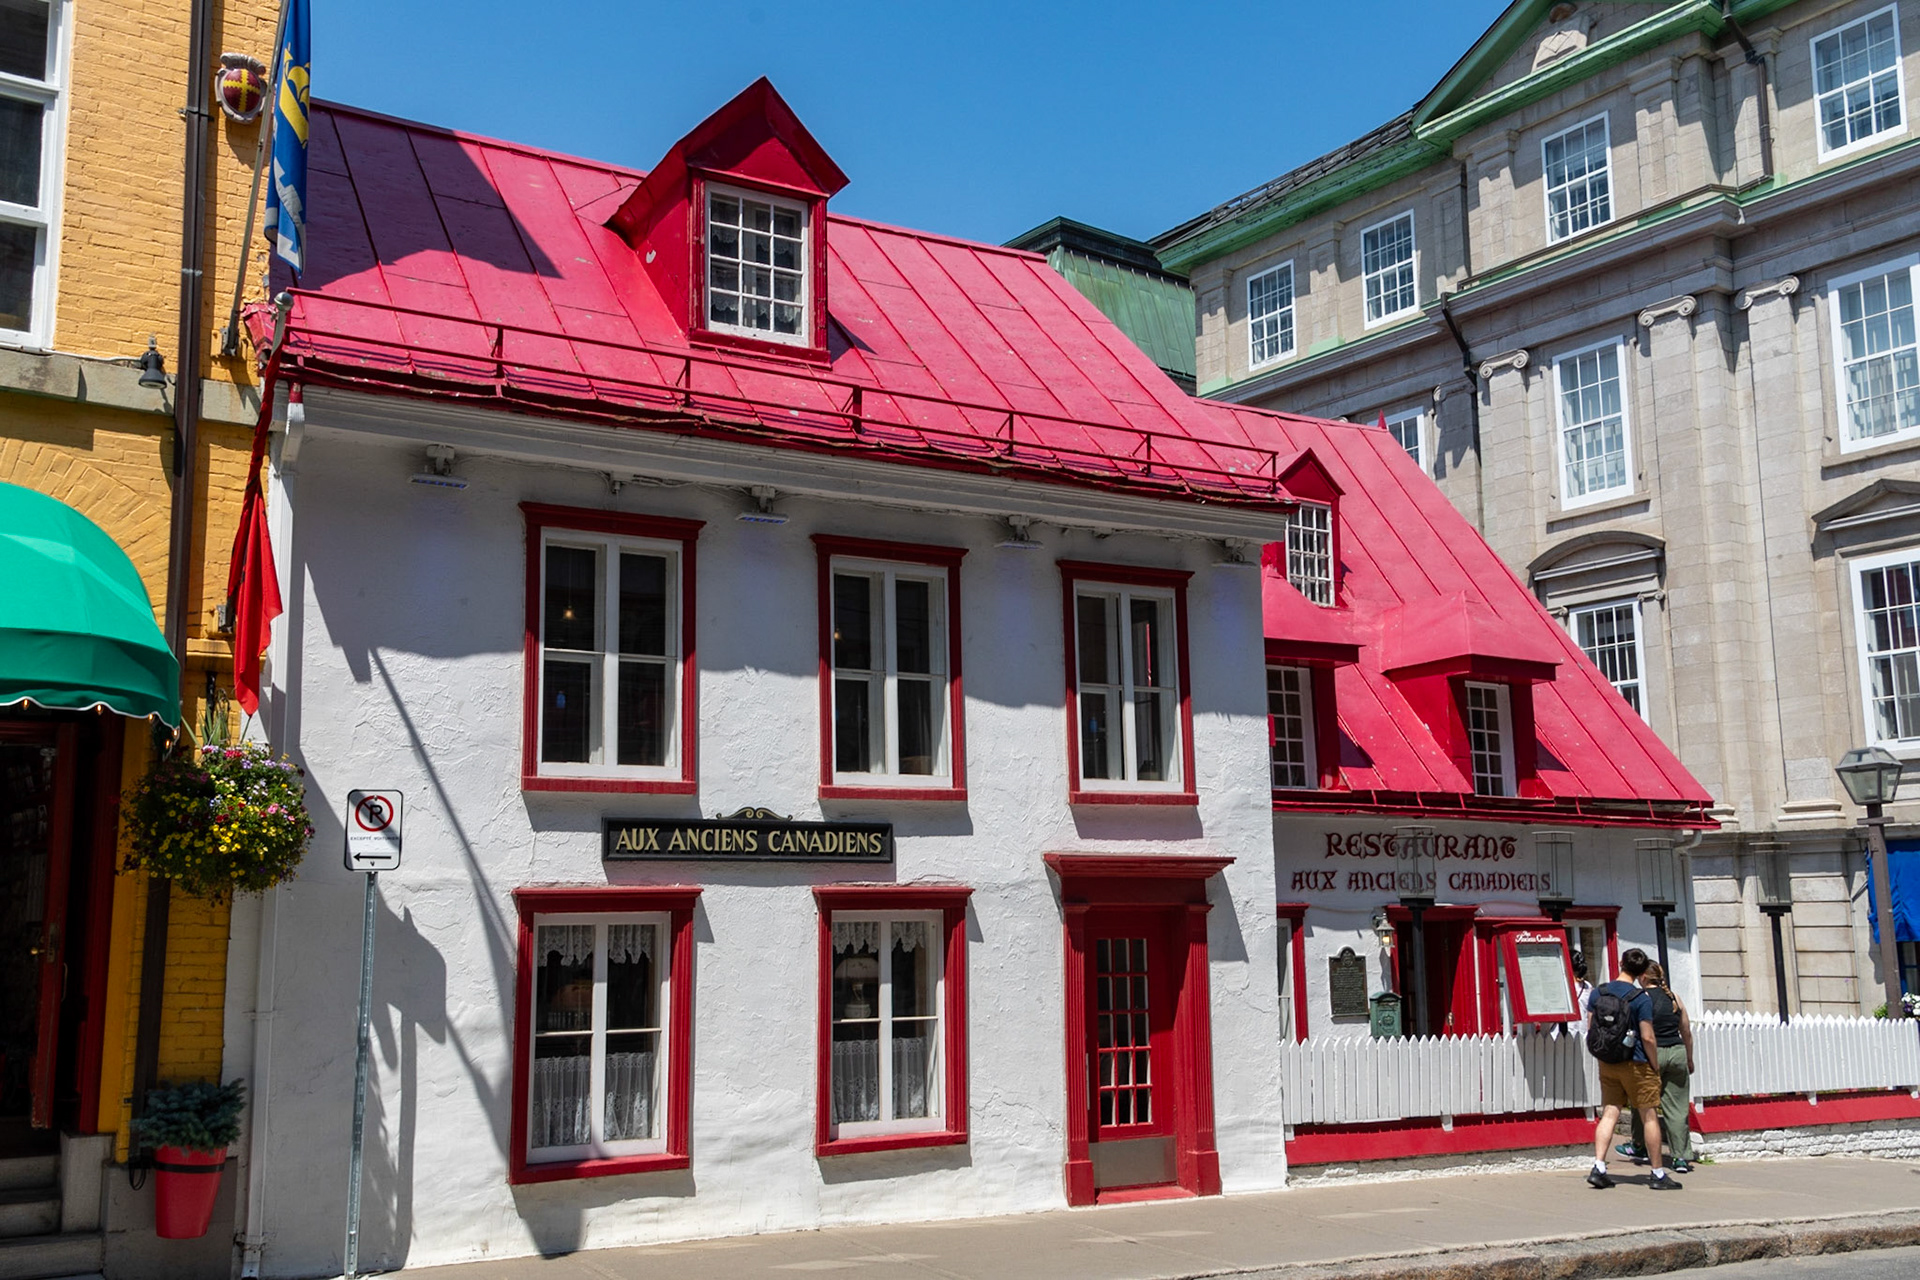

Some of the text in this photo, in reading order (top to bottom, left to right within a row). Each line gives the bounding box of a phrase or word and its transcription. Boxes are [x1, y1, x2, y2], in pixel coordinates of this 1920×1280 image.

[615, 827, 882, 854] AUX ANCIENS CANADIENS
[1324, 831, 1518, 862] RESTAURANT
[1291, 869, 1551, 893] AUX ANCIENS CANADIENS
